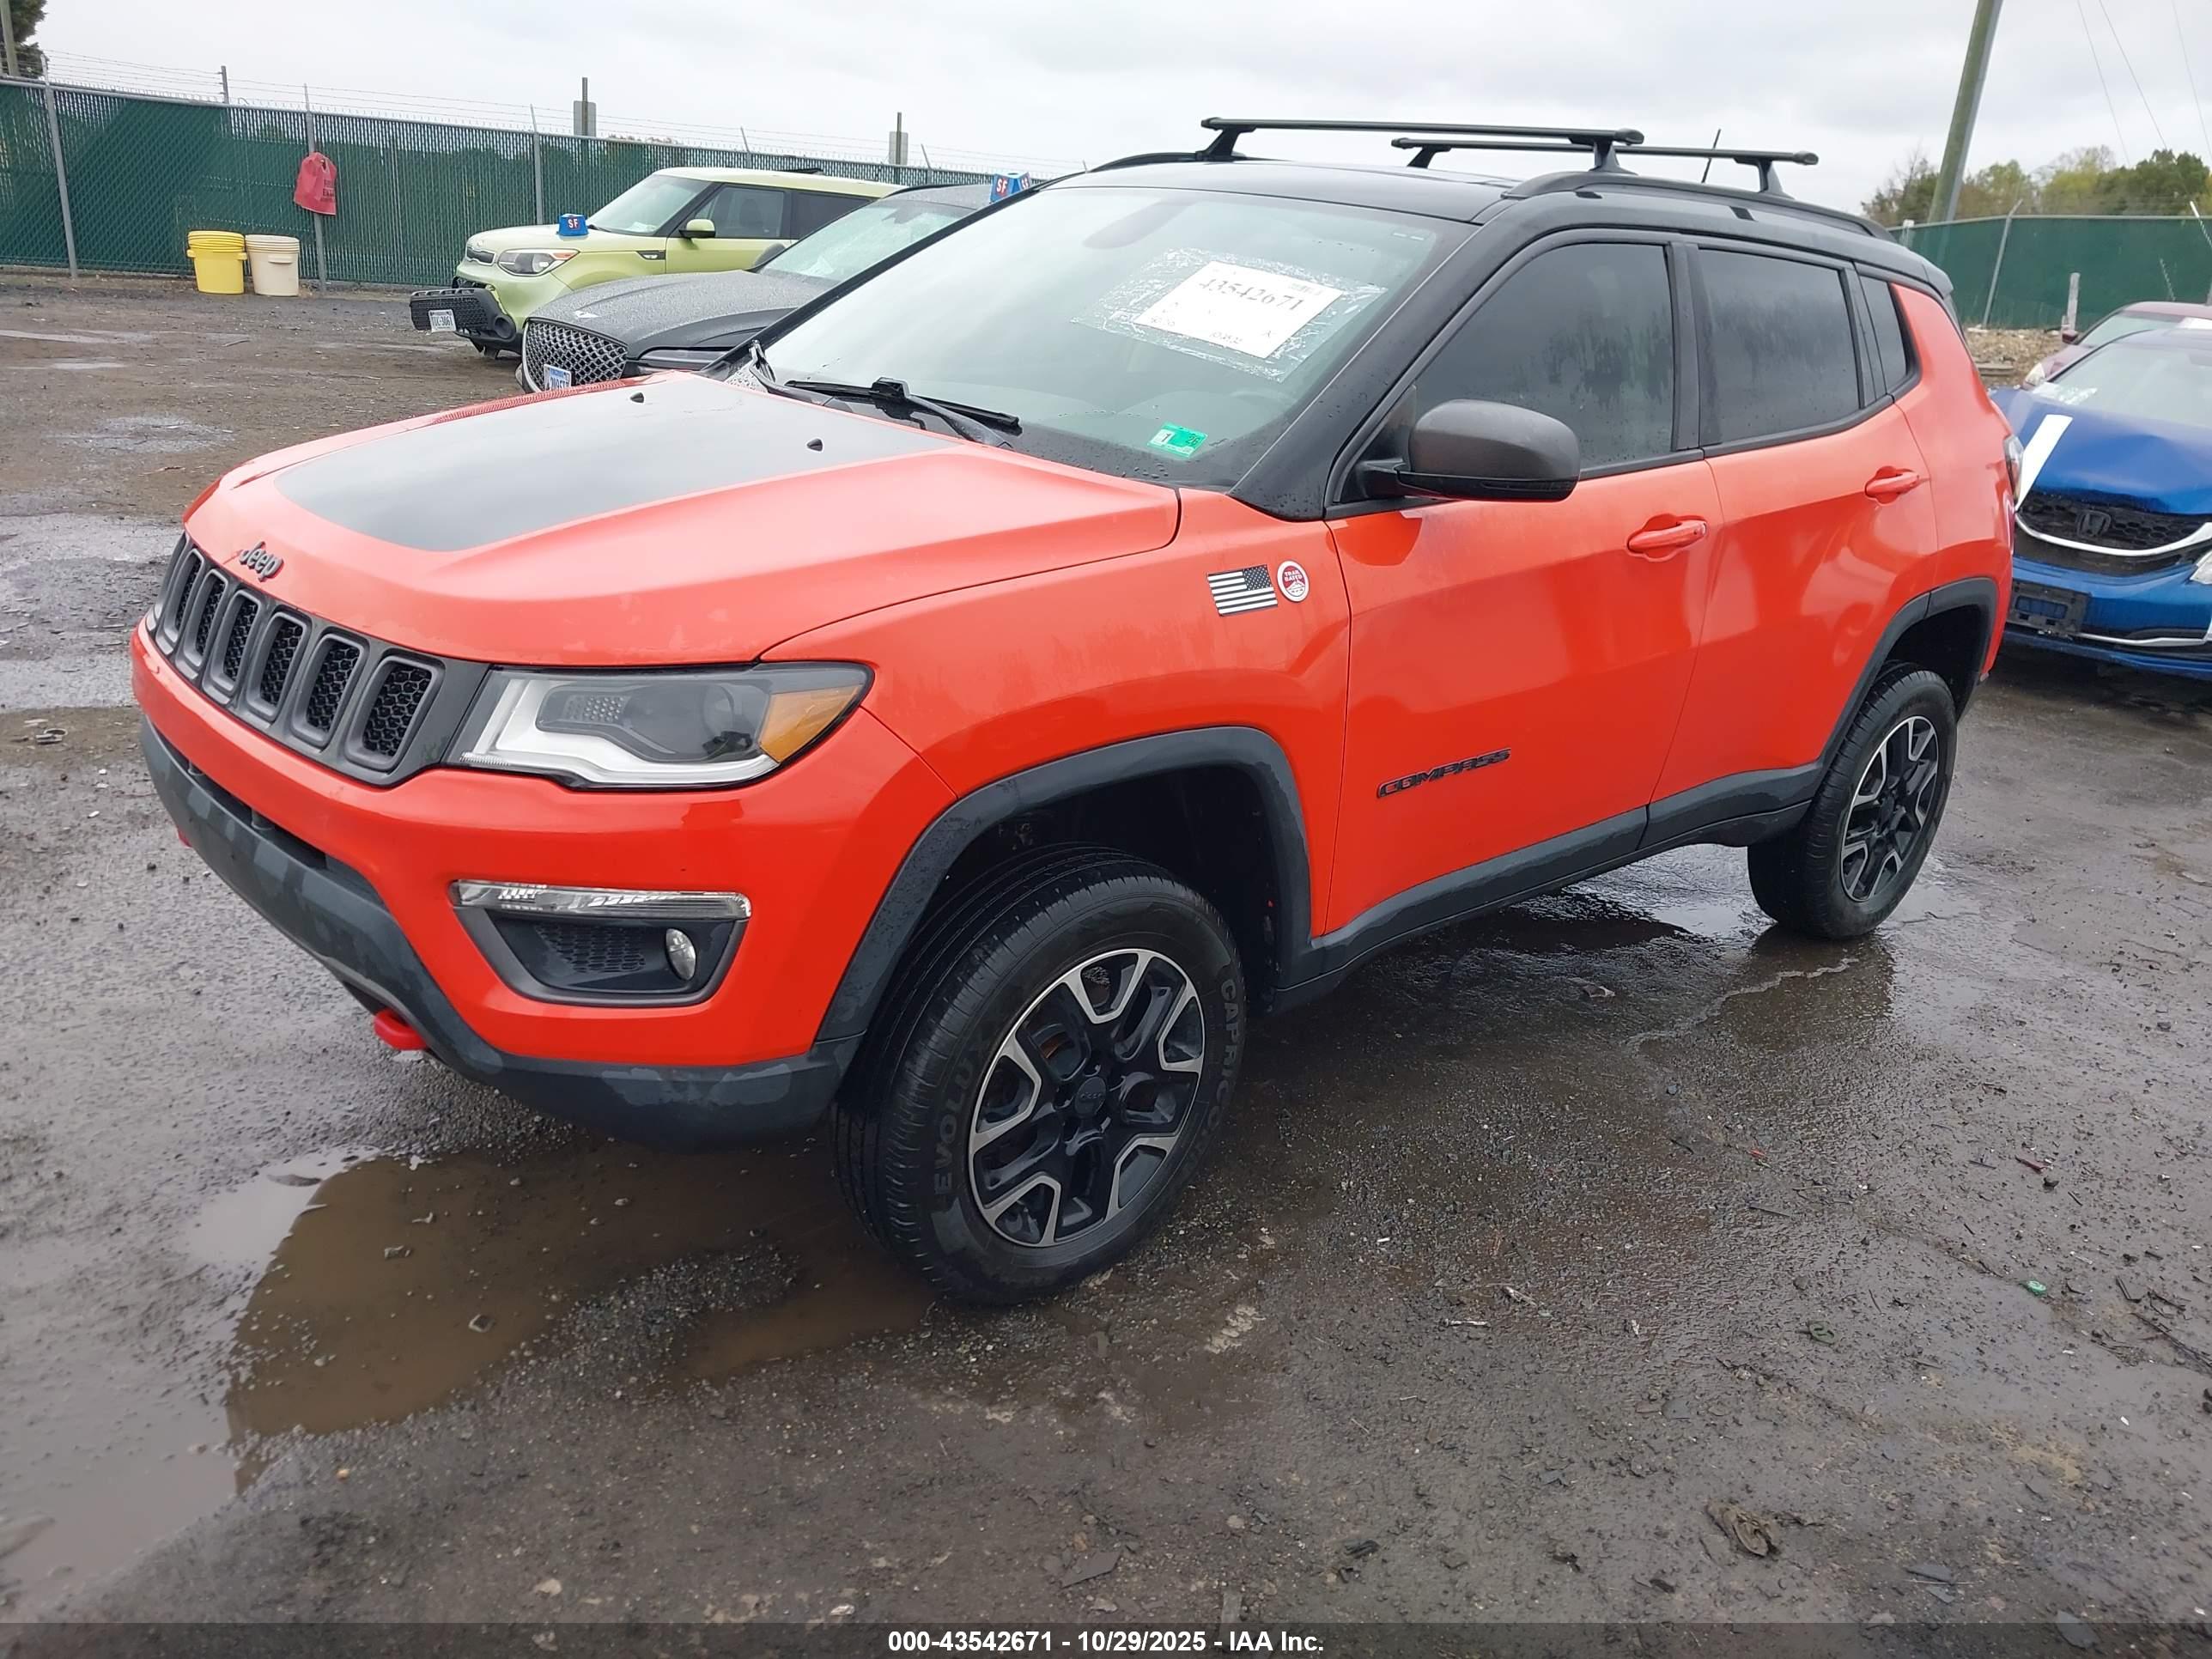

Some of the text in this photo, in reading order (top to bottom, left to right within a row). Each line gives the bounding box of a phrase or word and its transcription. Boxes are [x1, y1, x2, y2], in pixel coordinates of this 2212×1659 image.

[996, 178, 1008, 194] SF
[568, 218, 578, 228] SF
[240, 540, 284, 582] Jeep
[1376, 747, 1511, 799] COMPASS
